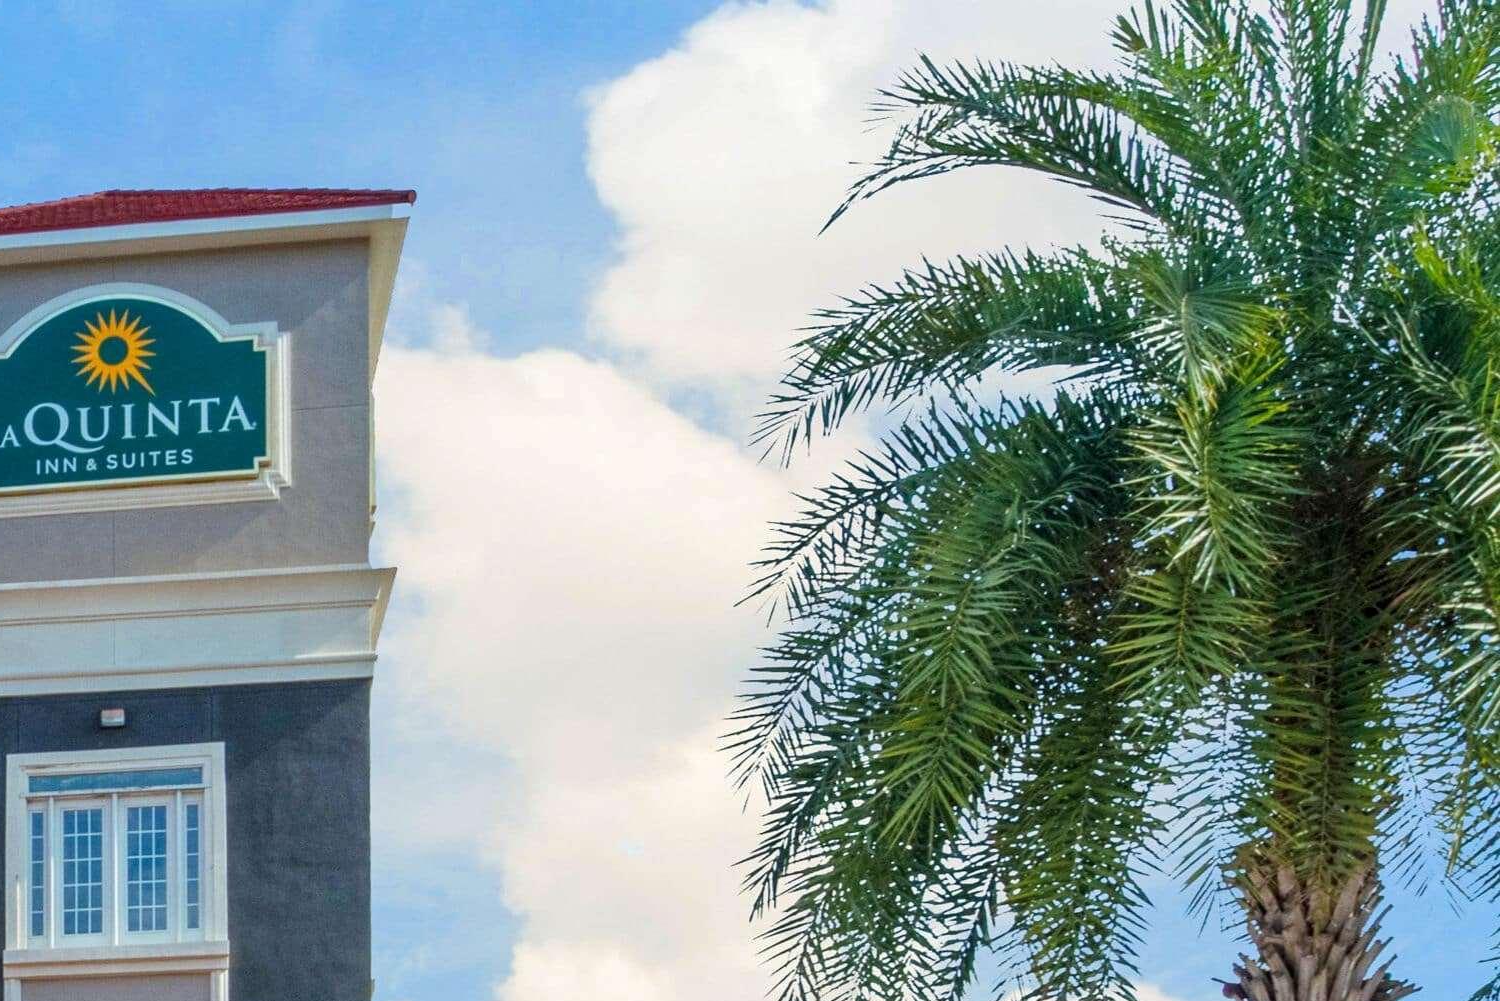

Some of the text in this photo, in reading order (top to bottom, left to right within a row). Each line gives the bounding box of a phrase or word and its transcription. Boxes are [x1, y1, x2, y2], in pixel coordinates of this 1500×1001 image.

[23, 395, 254, 454] QUINTA
[36, 448, 194, 475] INN & SUITES
